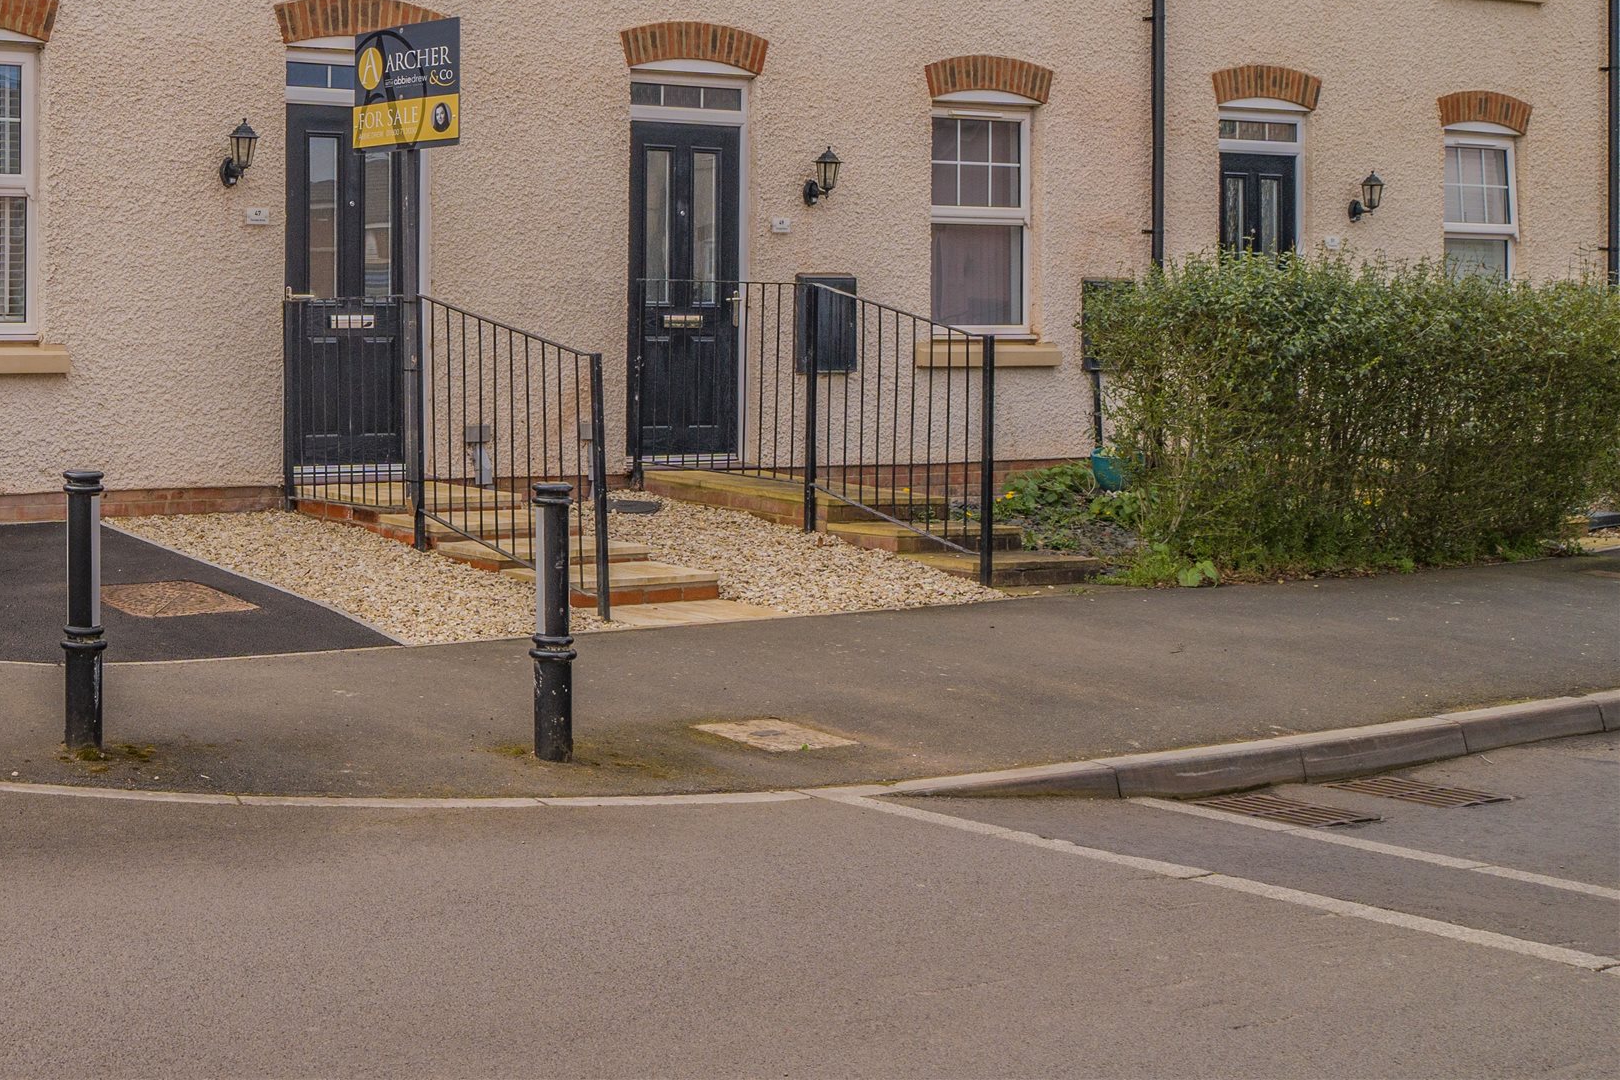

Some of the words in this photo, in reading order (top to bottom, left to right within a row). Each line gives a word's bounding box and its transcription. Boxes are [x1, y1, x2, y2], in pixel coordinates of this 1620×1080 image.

[385, 46, 452, 73] ARCHER
[358, 111, 384, 130] FOR
[387, 106, 419, 127] SALE
